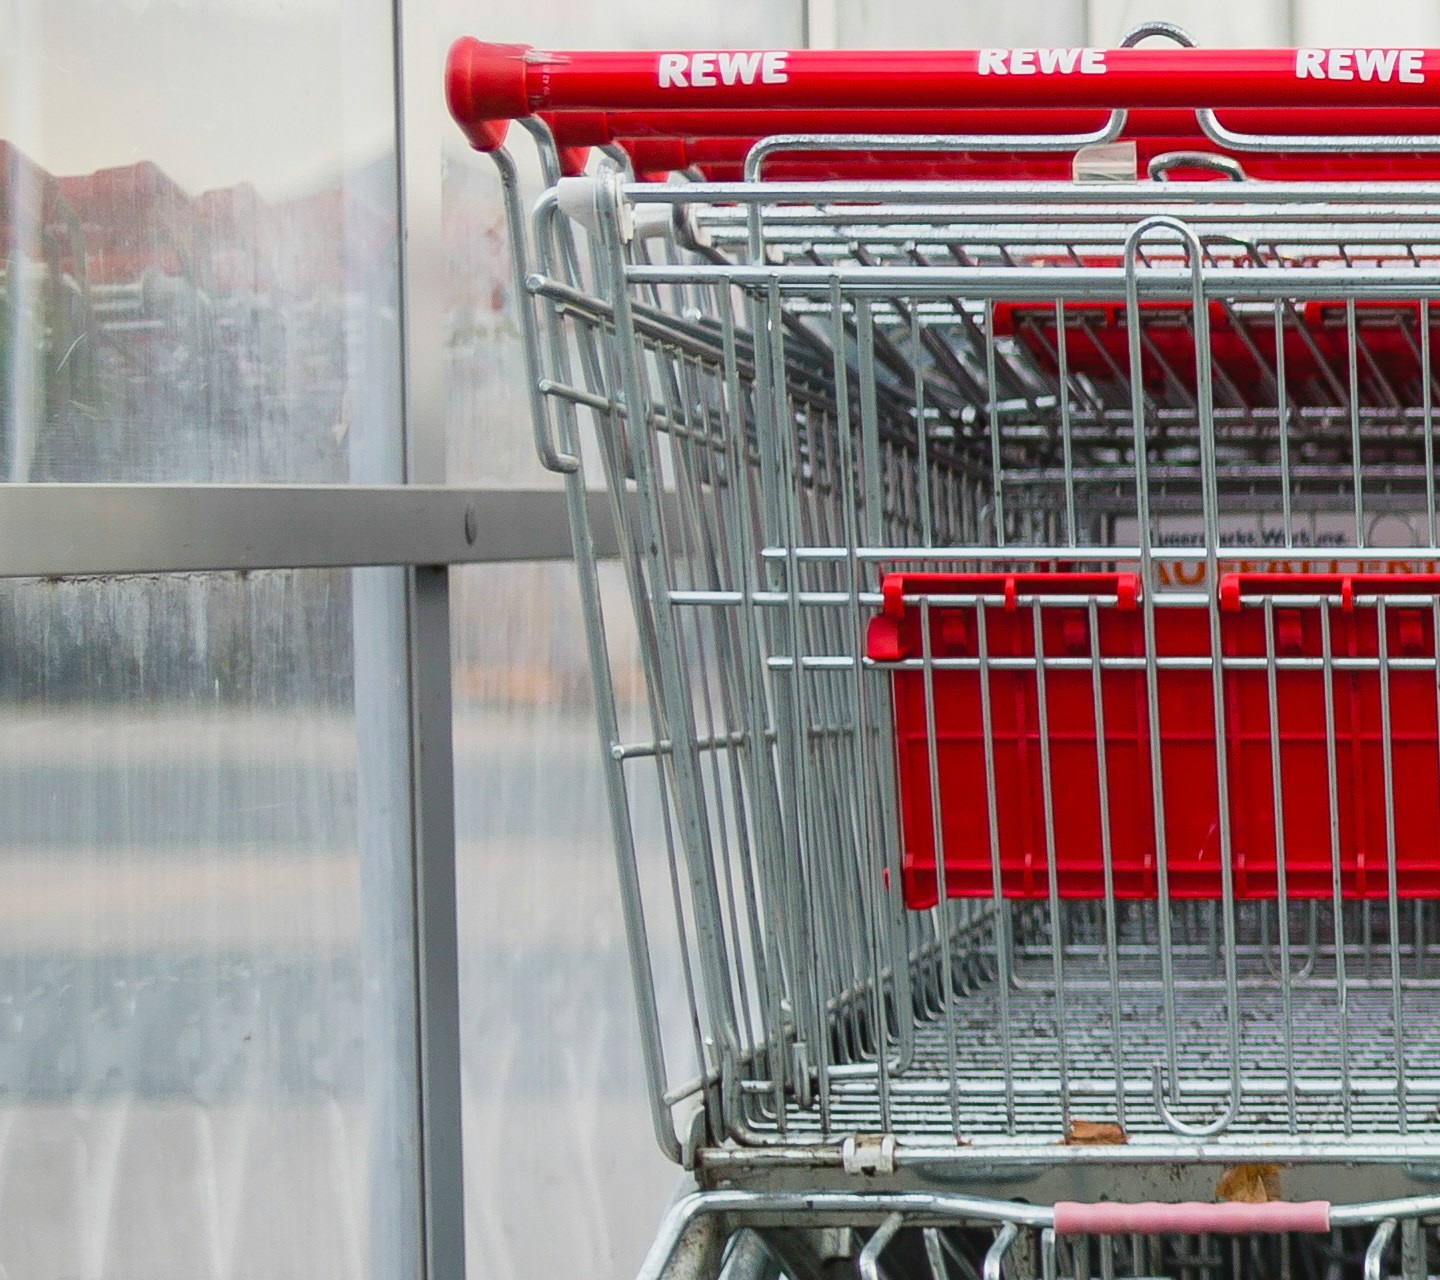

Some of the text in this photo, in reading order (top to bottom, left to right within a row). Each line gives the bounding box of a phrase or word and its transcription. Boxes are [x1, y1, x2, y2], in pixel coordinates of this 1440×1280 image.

[658, 51, 789, 89] REWE
[977, 48, 1108, 75] REWE
[1295, 48, 1425, 84] REWE
